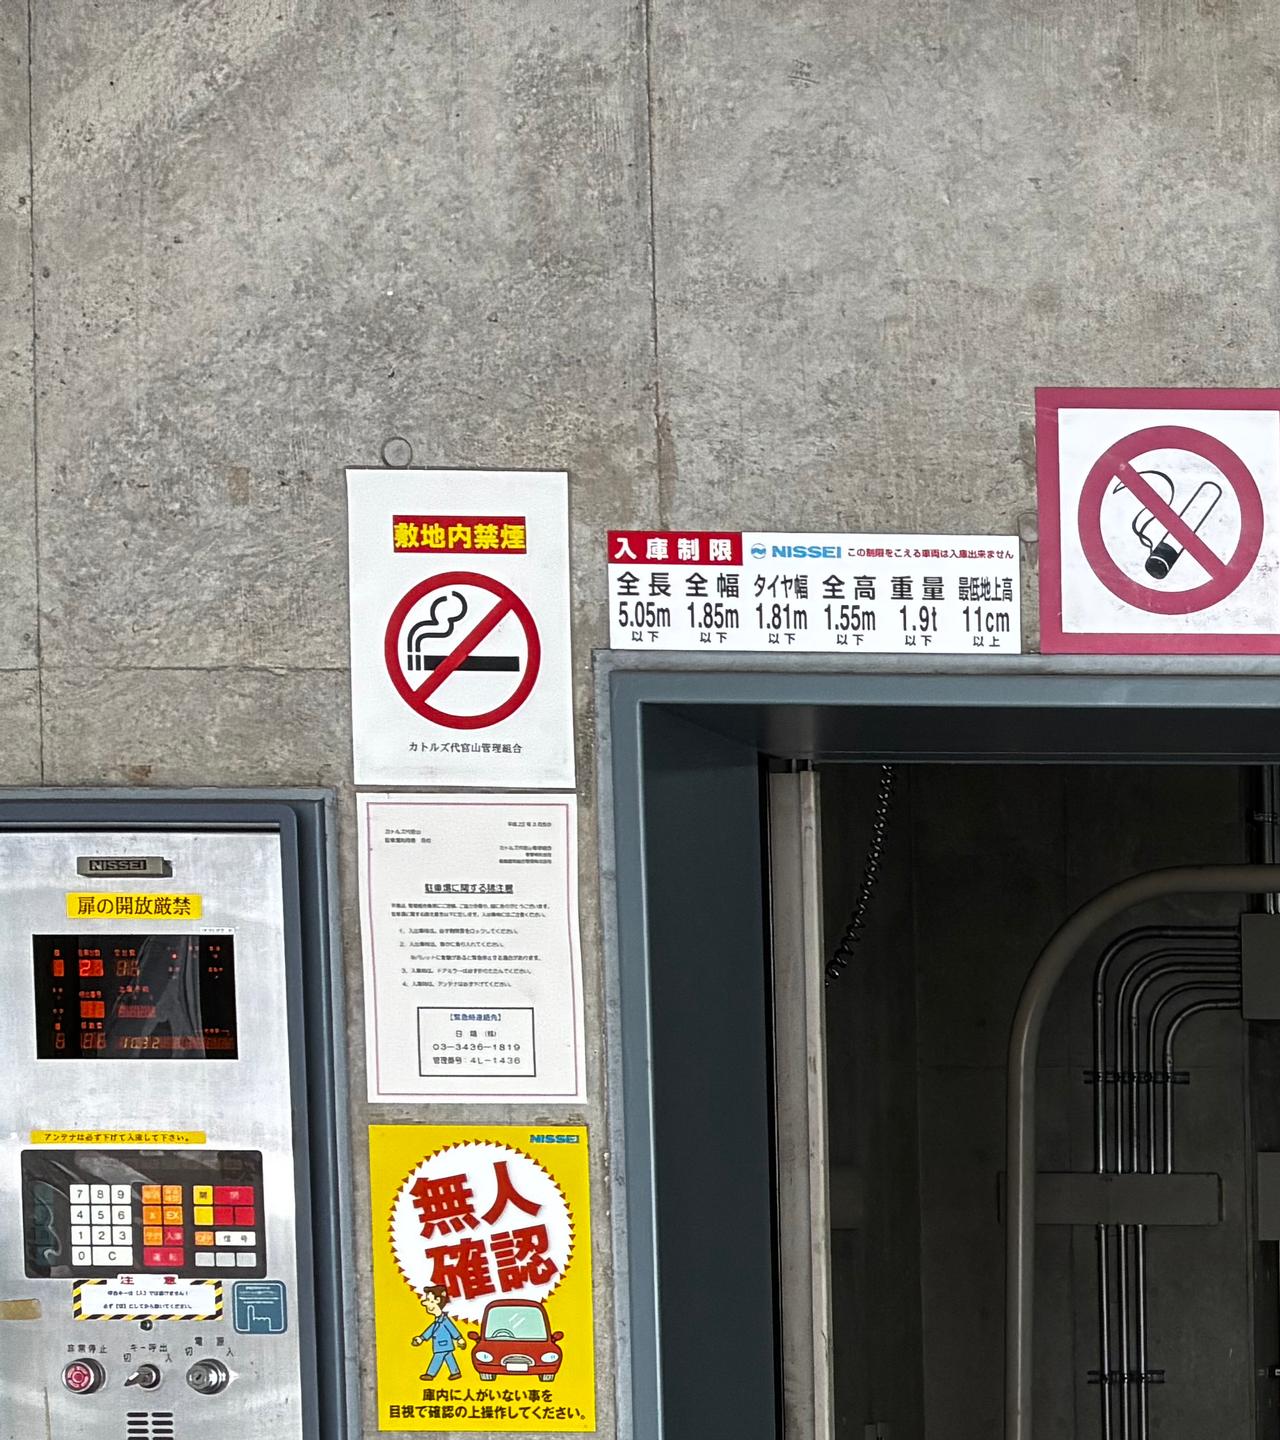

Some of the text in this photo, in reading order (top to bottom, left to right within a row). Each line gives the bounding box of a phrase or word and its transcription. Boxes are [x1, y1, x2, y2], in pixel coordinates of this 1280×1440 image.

[393, 523, 527, 551] 敷地内禁煙
[614, 537, 732, 562] 入庫制限
[771, 546, 842, 558] NISSEI
[847, 548, 1014, 560] この制限をこえる車両は入庫出来ません
[617, 571, 1013, 602] 全長 全幅 タイヤ幅 全高 重量 最低地上高
[618, 601, 1010, 633] 5.05m 1.85m 1.81m 1.55m 1.9t 11cm
[632, 631, 1000, 647] 以下 以下 以下 以下 以下 以上
[408, 741, 524, 755] カトルズ代官山管理組合
[89, 860, 147, 871] NISSEI
[77, 896, 192, 916] 扉の開放厳禁
[530, 1134, 580, 1144] NISSEI
[76, 1189, 124, 1199] 7 8 9
[409, 1160, 543, 1240] 無人
[76, 1210, 125, 1220] 4 5 6
[98, 1231, 105, 1240] 2
[119, 1231, 126, 1241] 3
[108, 1251, 117, 1261] C
[424, 1223, 560, 1301] 確認
[422, 1388, 553, 1403] 庫内に人がいない事を
[389, 1404, 586, 1420] 目視で確認の上操作してください。
